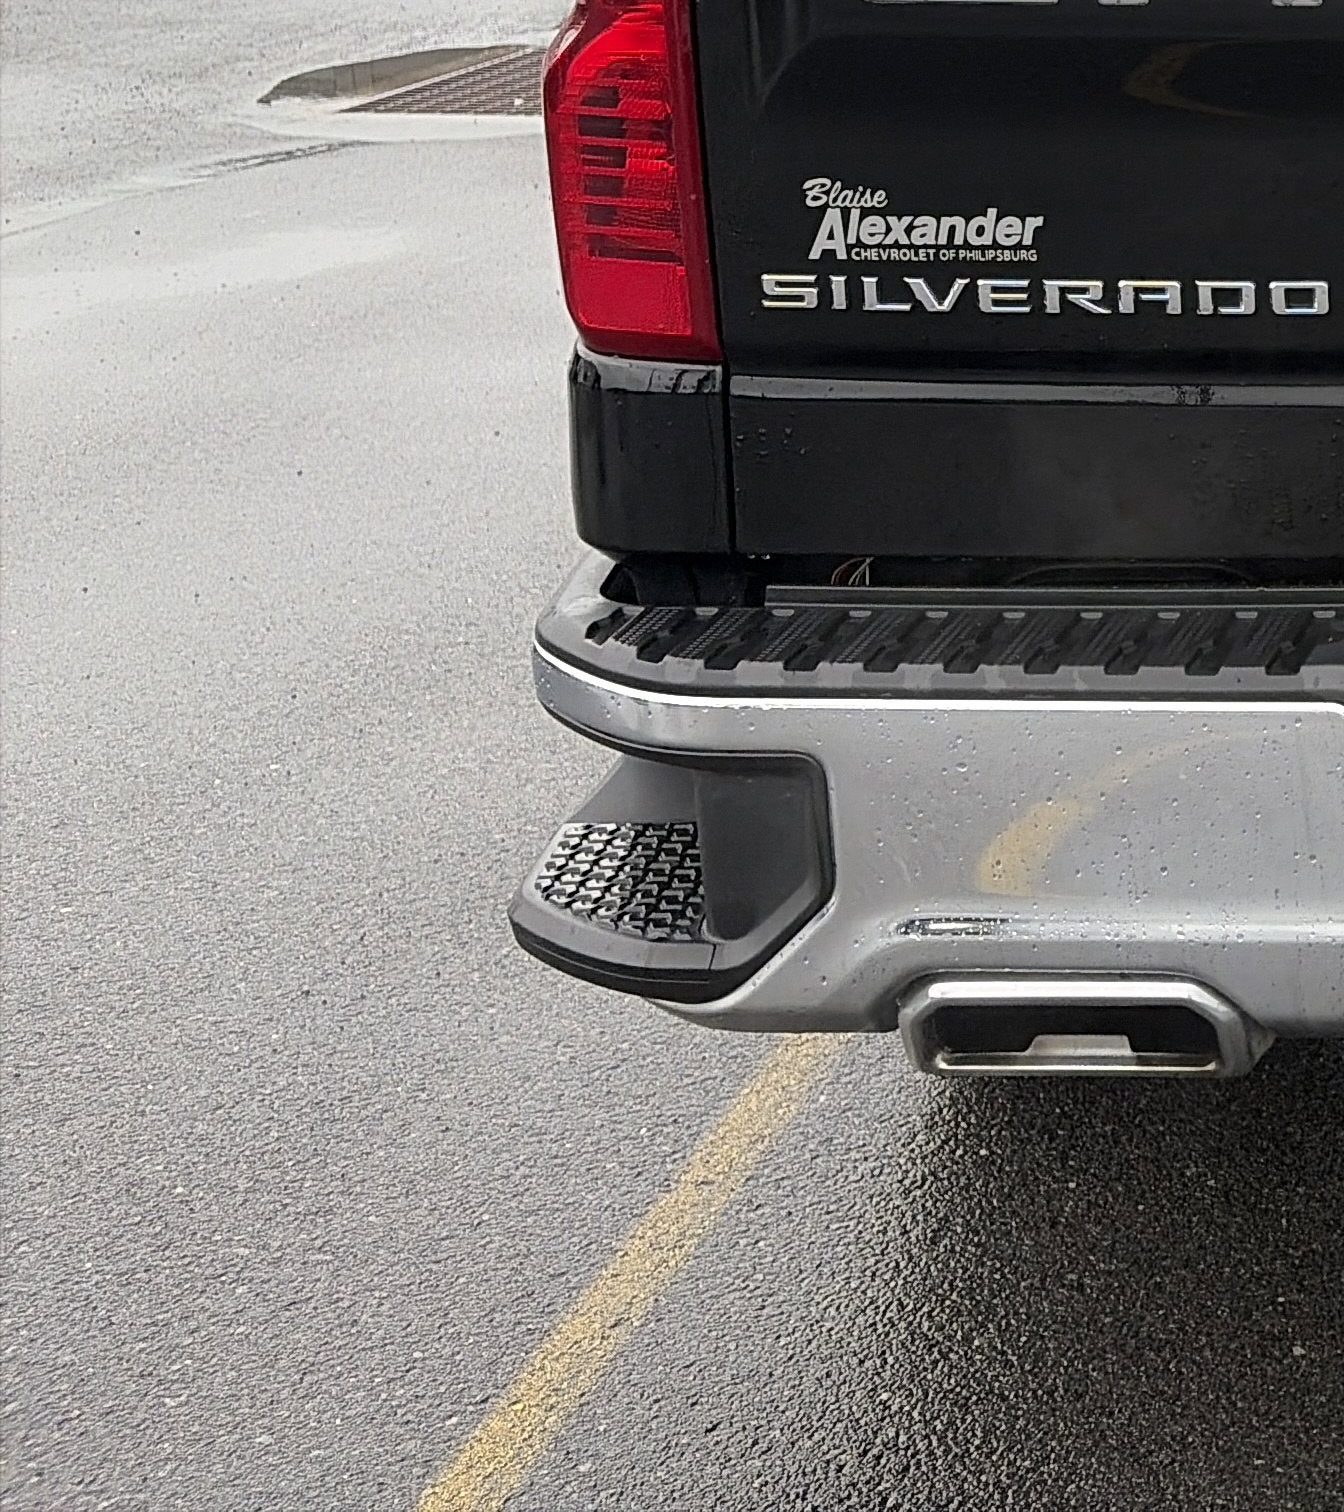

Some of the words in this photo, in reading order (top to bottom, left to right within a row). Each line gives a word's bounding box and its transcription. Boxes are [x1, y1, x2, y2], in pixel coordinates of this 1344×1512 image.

[802, 177, 889, 208] Blaise
[807, 207, 1044, 260] Alexander
[851, 248, 936, 261] CHEVROLET
[939, 248, 957, 261] OF
[958, 249, 1038, 261] PHILIPSBURG
[760, 273, 1330, 315] SILVERADO
